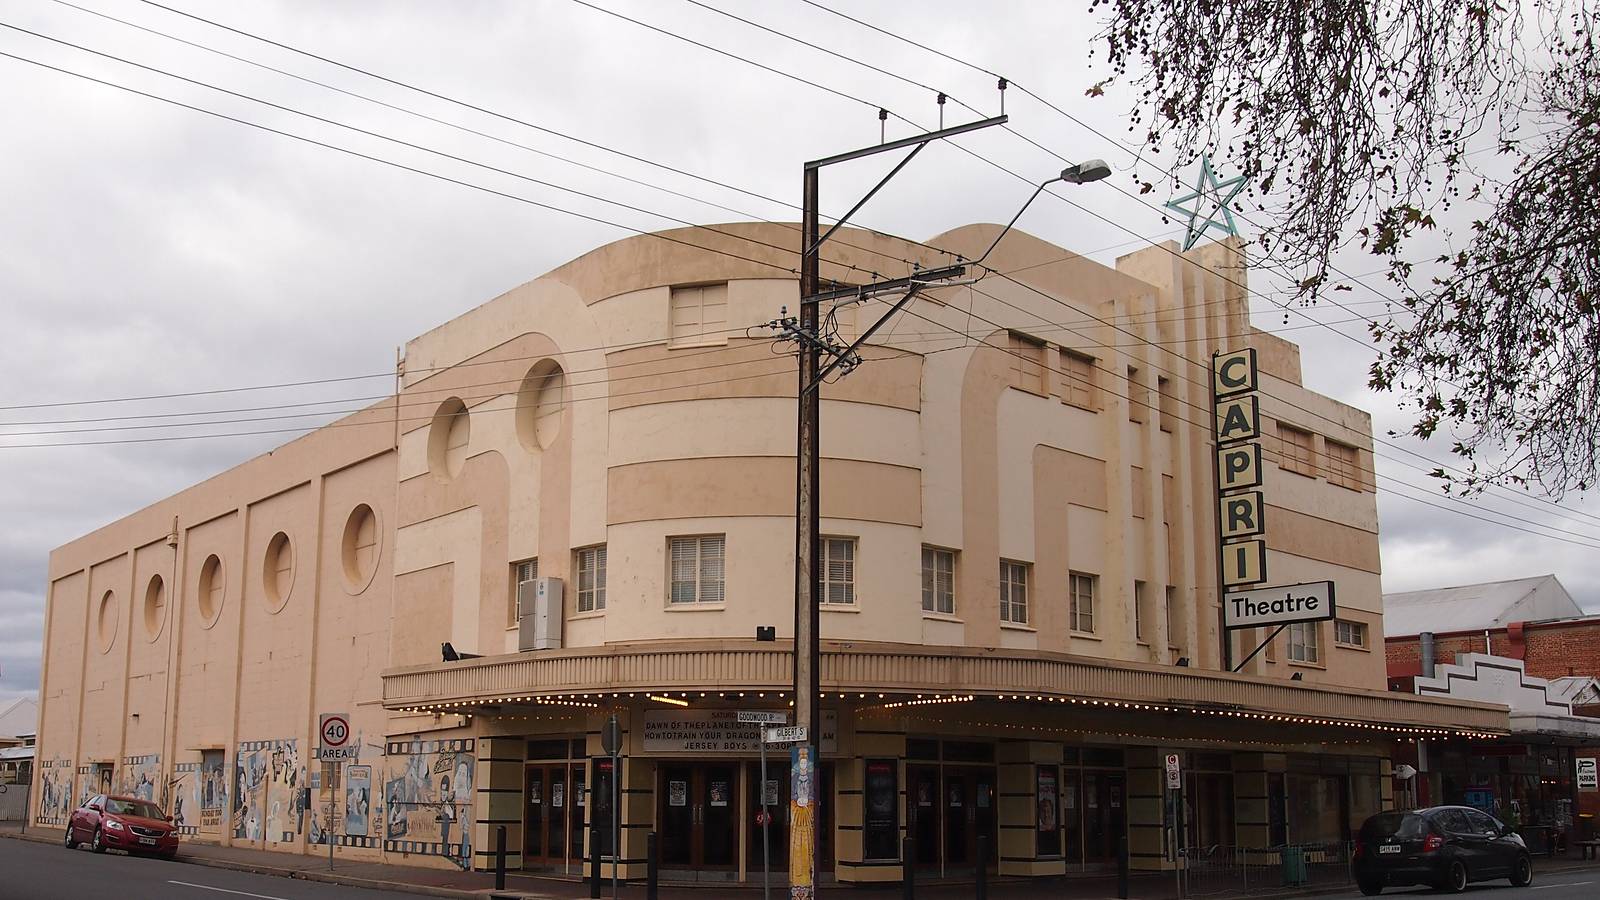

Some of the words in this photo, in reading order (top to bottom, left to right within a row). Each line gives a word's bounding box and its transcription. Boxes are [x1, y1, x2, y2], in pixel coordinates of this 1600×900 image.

[1219, 356, 1255, 579] CAPRI
[1231, 594, 1319, 619] Theatre
[739, 713, 767, 721] GOODWOOD
[326, 725, 345, 738] 40
[699, 732, 721, 740] YOUR
[777, 728, 797, 737] GILBERT
[322, 749, 348, 758] AREA
